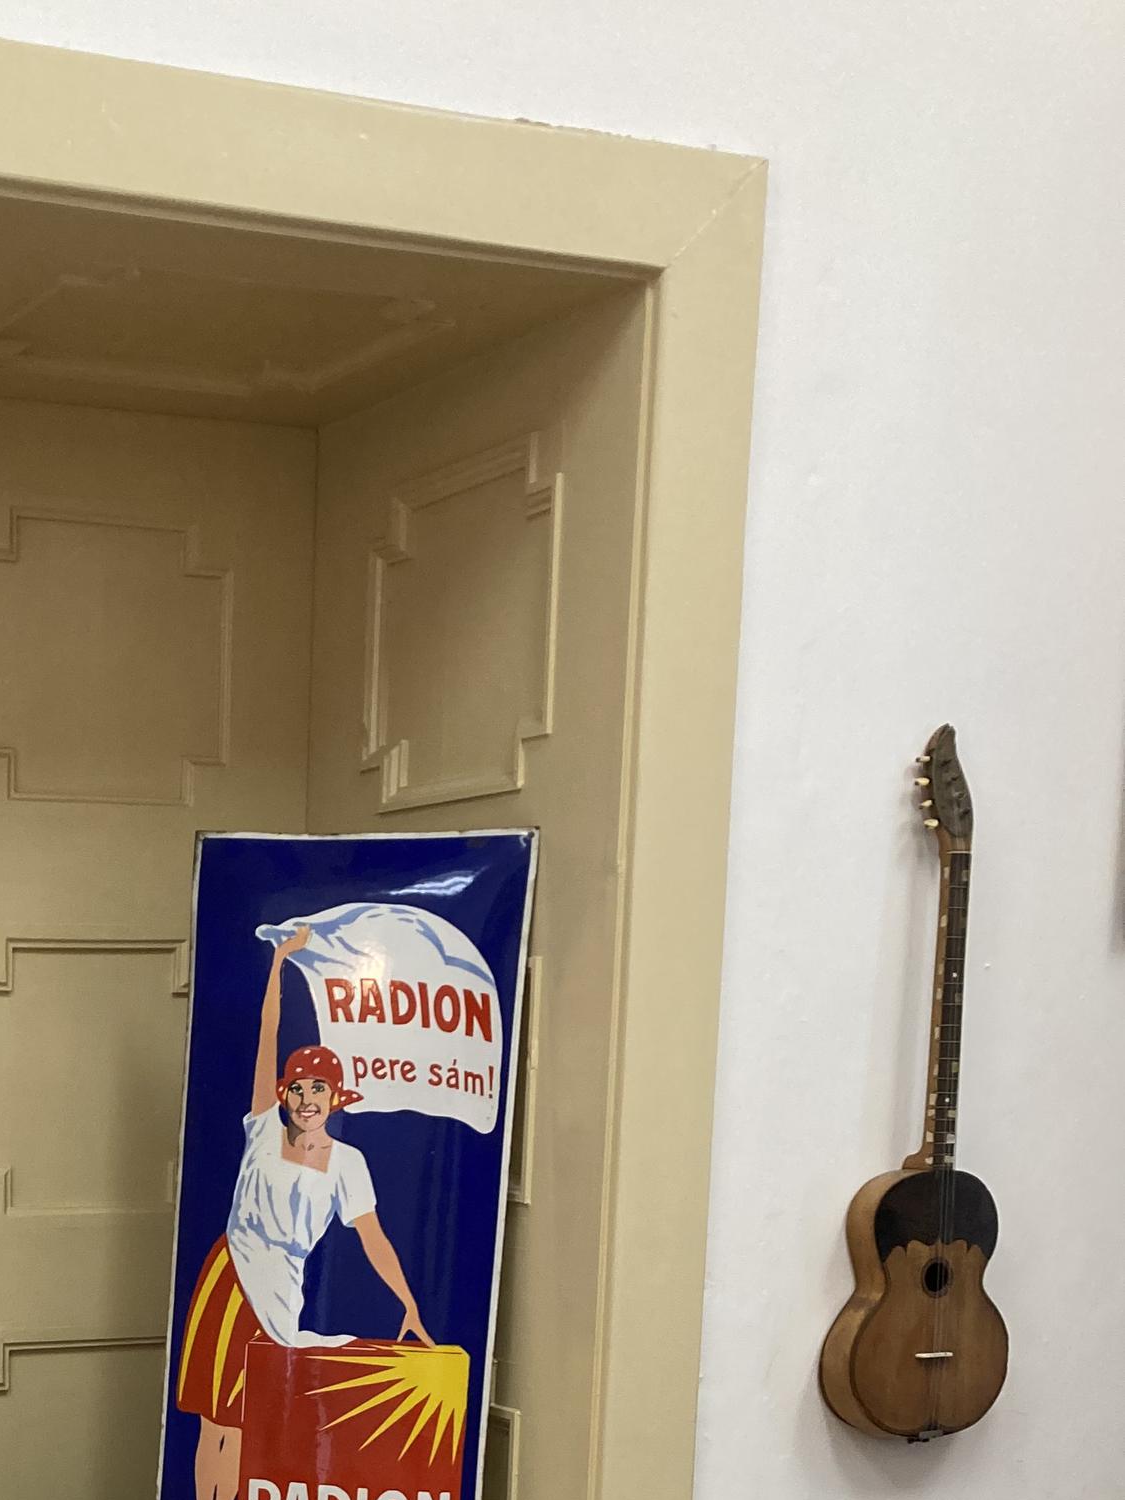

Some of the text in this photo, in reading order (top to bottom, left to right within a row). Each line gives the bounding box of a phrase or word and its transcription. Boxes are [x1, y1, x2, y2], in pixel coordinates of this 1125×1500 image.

[325, 978, 493, 1043] RADION
[352, 1055, 494, 1099] pere sám!
